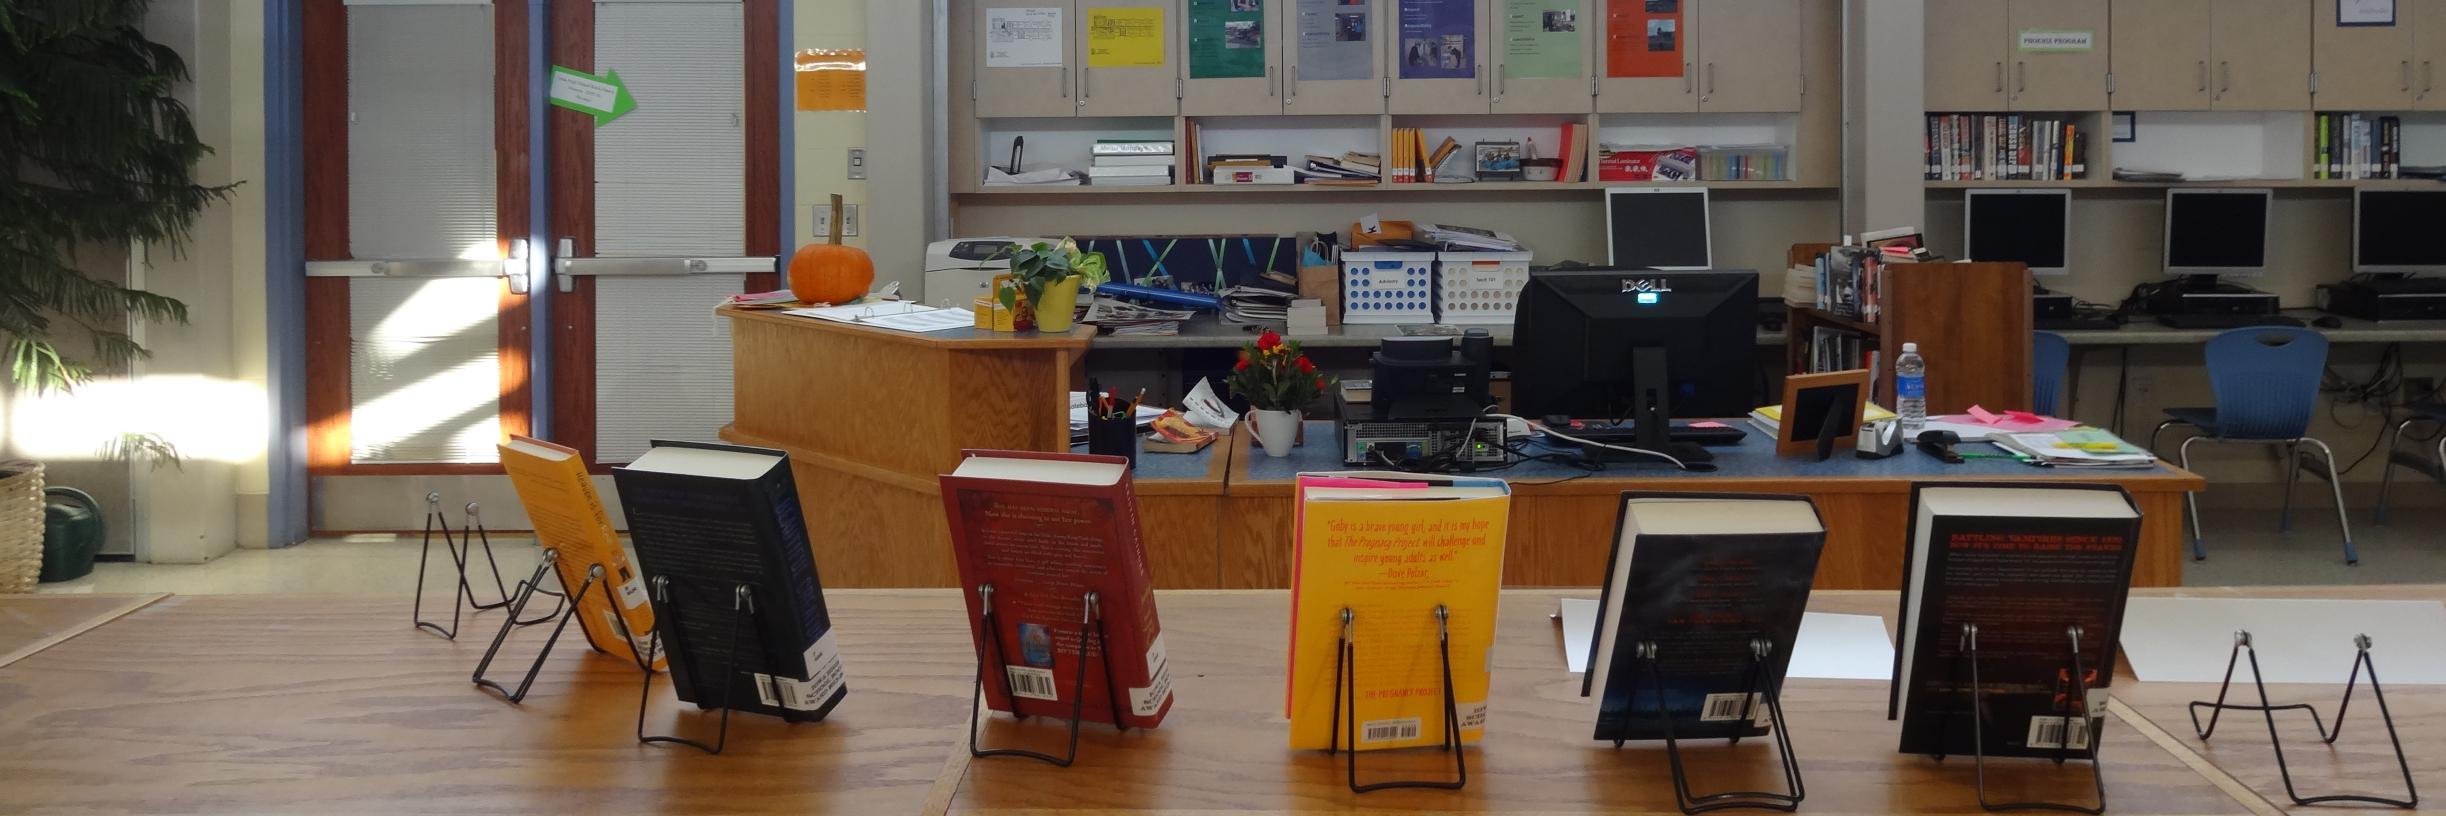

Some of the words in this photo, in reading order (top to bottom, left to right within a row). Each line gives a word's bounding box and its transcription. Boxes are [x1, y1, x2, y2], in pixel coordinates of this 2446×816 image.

[2054, 37, 2087, 45] PROGRAM
[1621, 278, 1672, 293] DELL
[1366, 521, 1386, 531] brave
[1388, 522, 1409, 534] young
[1428, 520, 1441, 531] and
[1473, 518, 1489, 531] hope
[1328, 536, 1343, 547] that
[1345, 536, 1358, 547] The
[1395, 536, 1420, 550] Project
[1423, 536, 1435, 547] will
[1437, 534, 1469, 549] challenge
[1472, 534, 1486, 545] and
[1380, 553, 1402, 566] young
[1378, 688, 1414, 698] PREGNANCY
